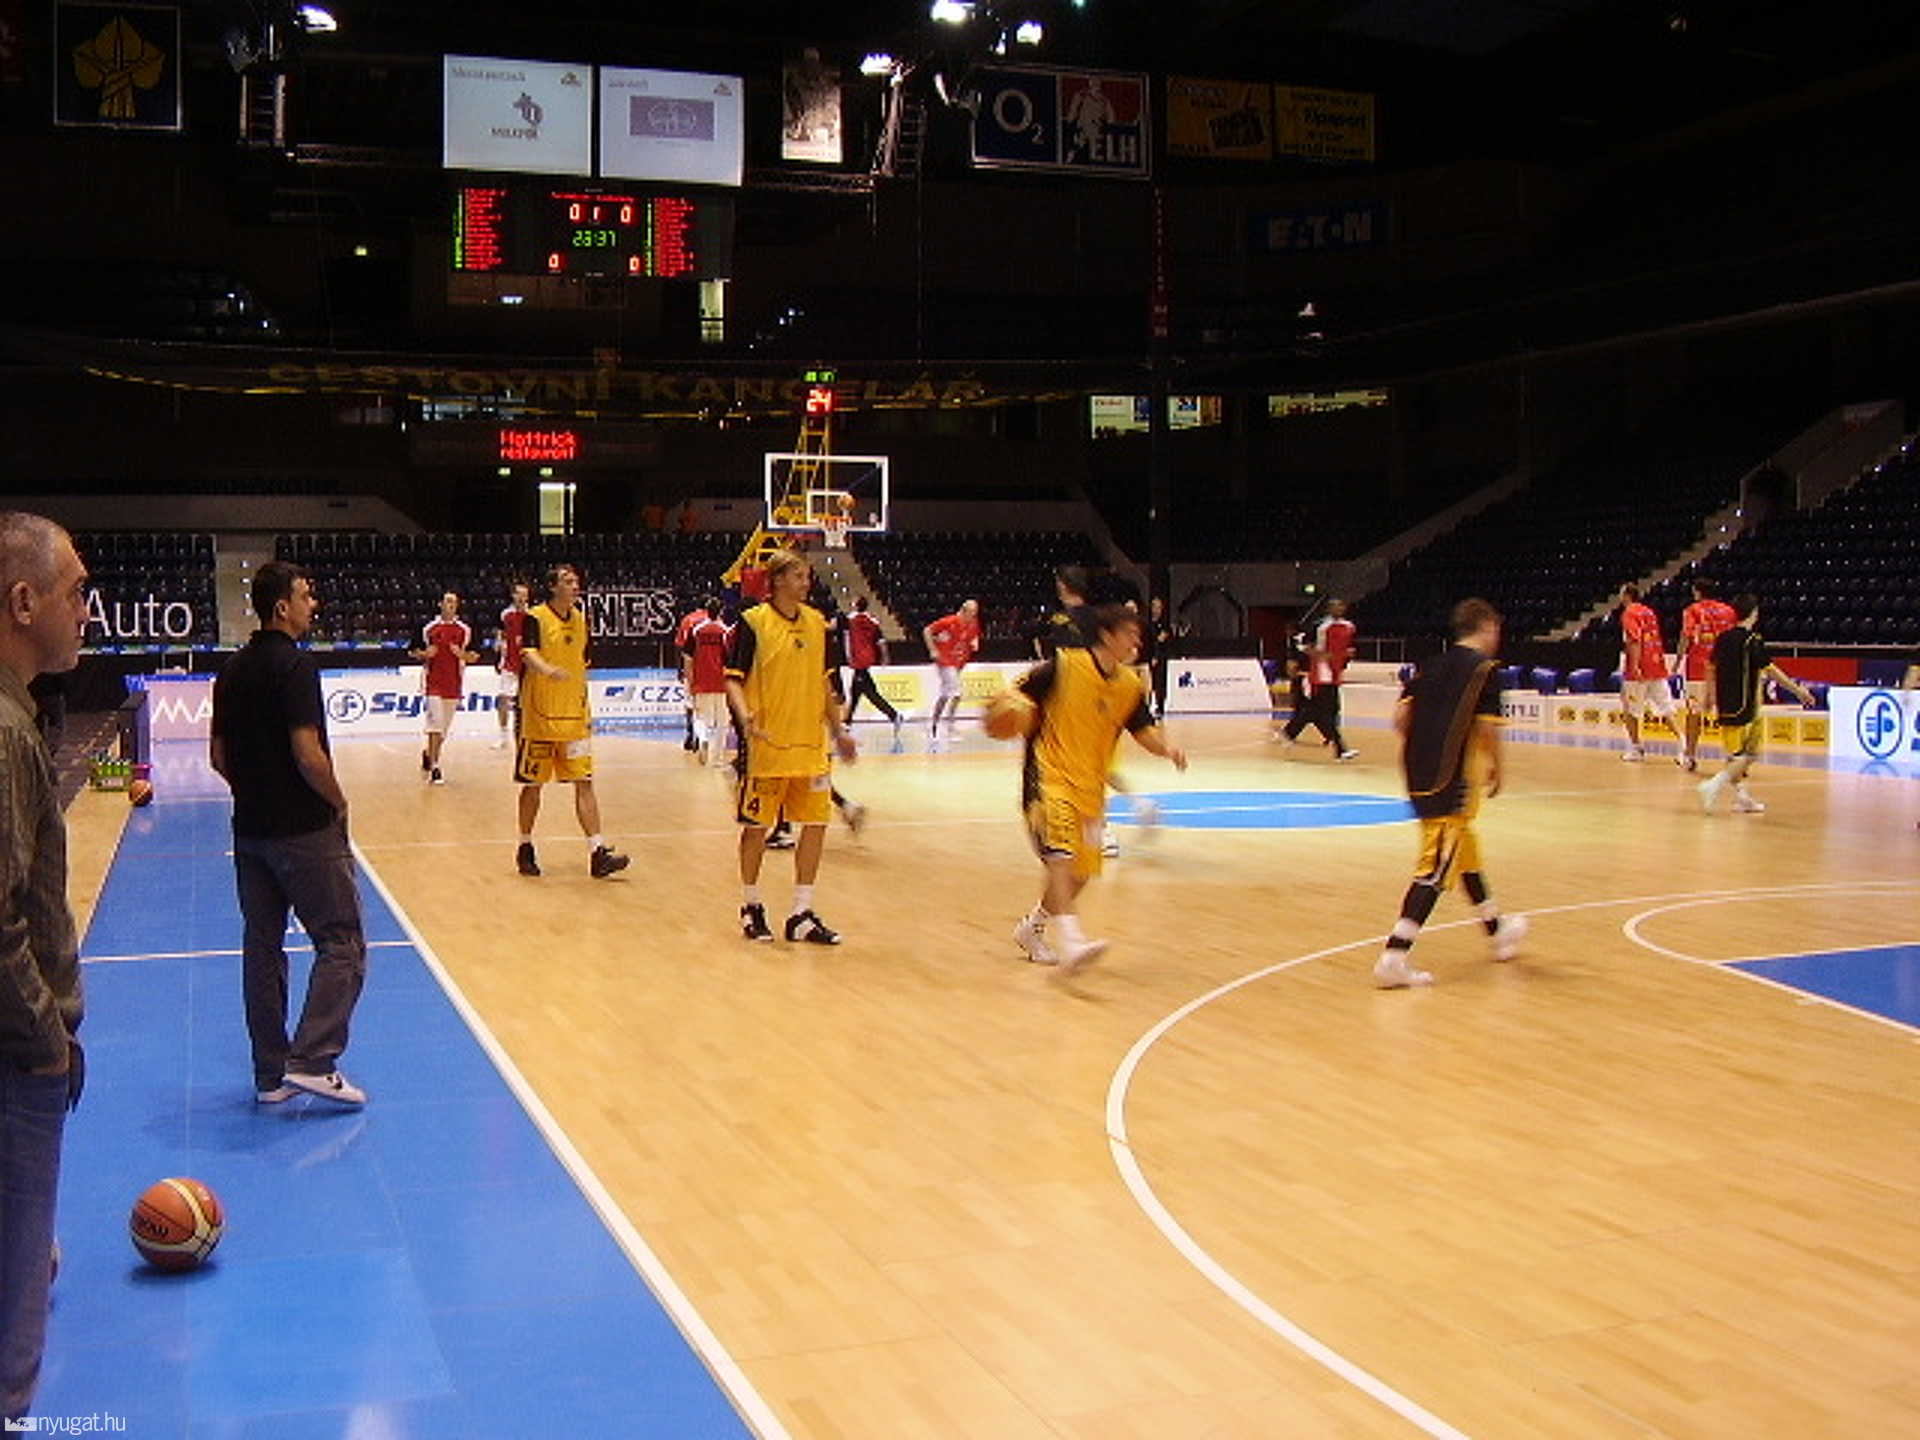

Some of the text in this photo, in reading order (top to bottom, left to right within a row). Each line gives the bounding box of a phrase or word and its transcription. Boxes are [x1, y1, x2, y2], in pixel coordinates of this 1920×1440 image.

[569, 204, 580, 221] 0
[620, 206, 631, 224] 0
[548, 254, 559, 269] 0
[628, 256, 640, 272] 0
[806, 388, 832, 412] 24
[79, 587, 193, 637] Auto
[574, 589, 676, 637] NES
[746, 799, 760, 817] 4
